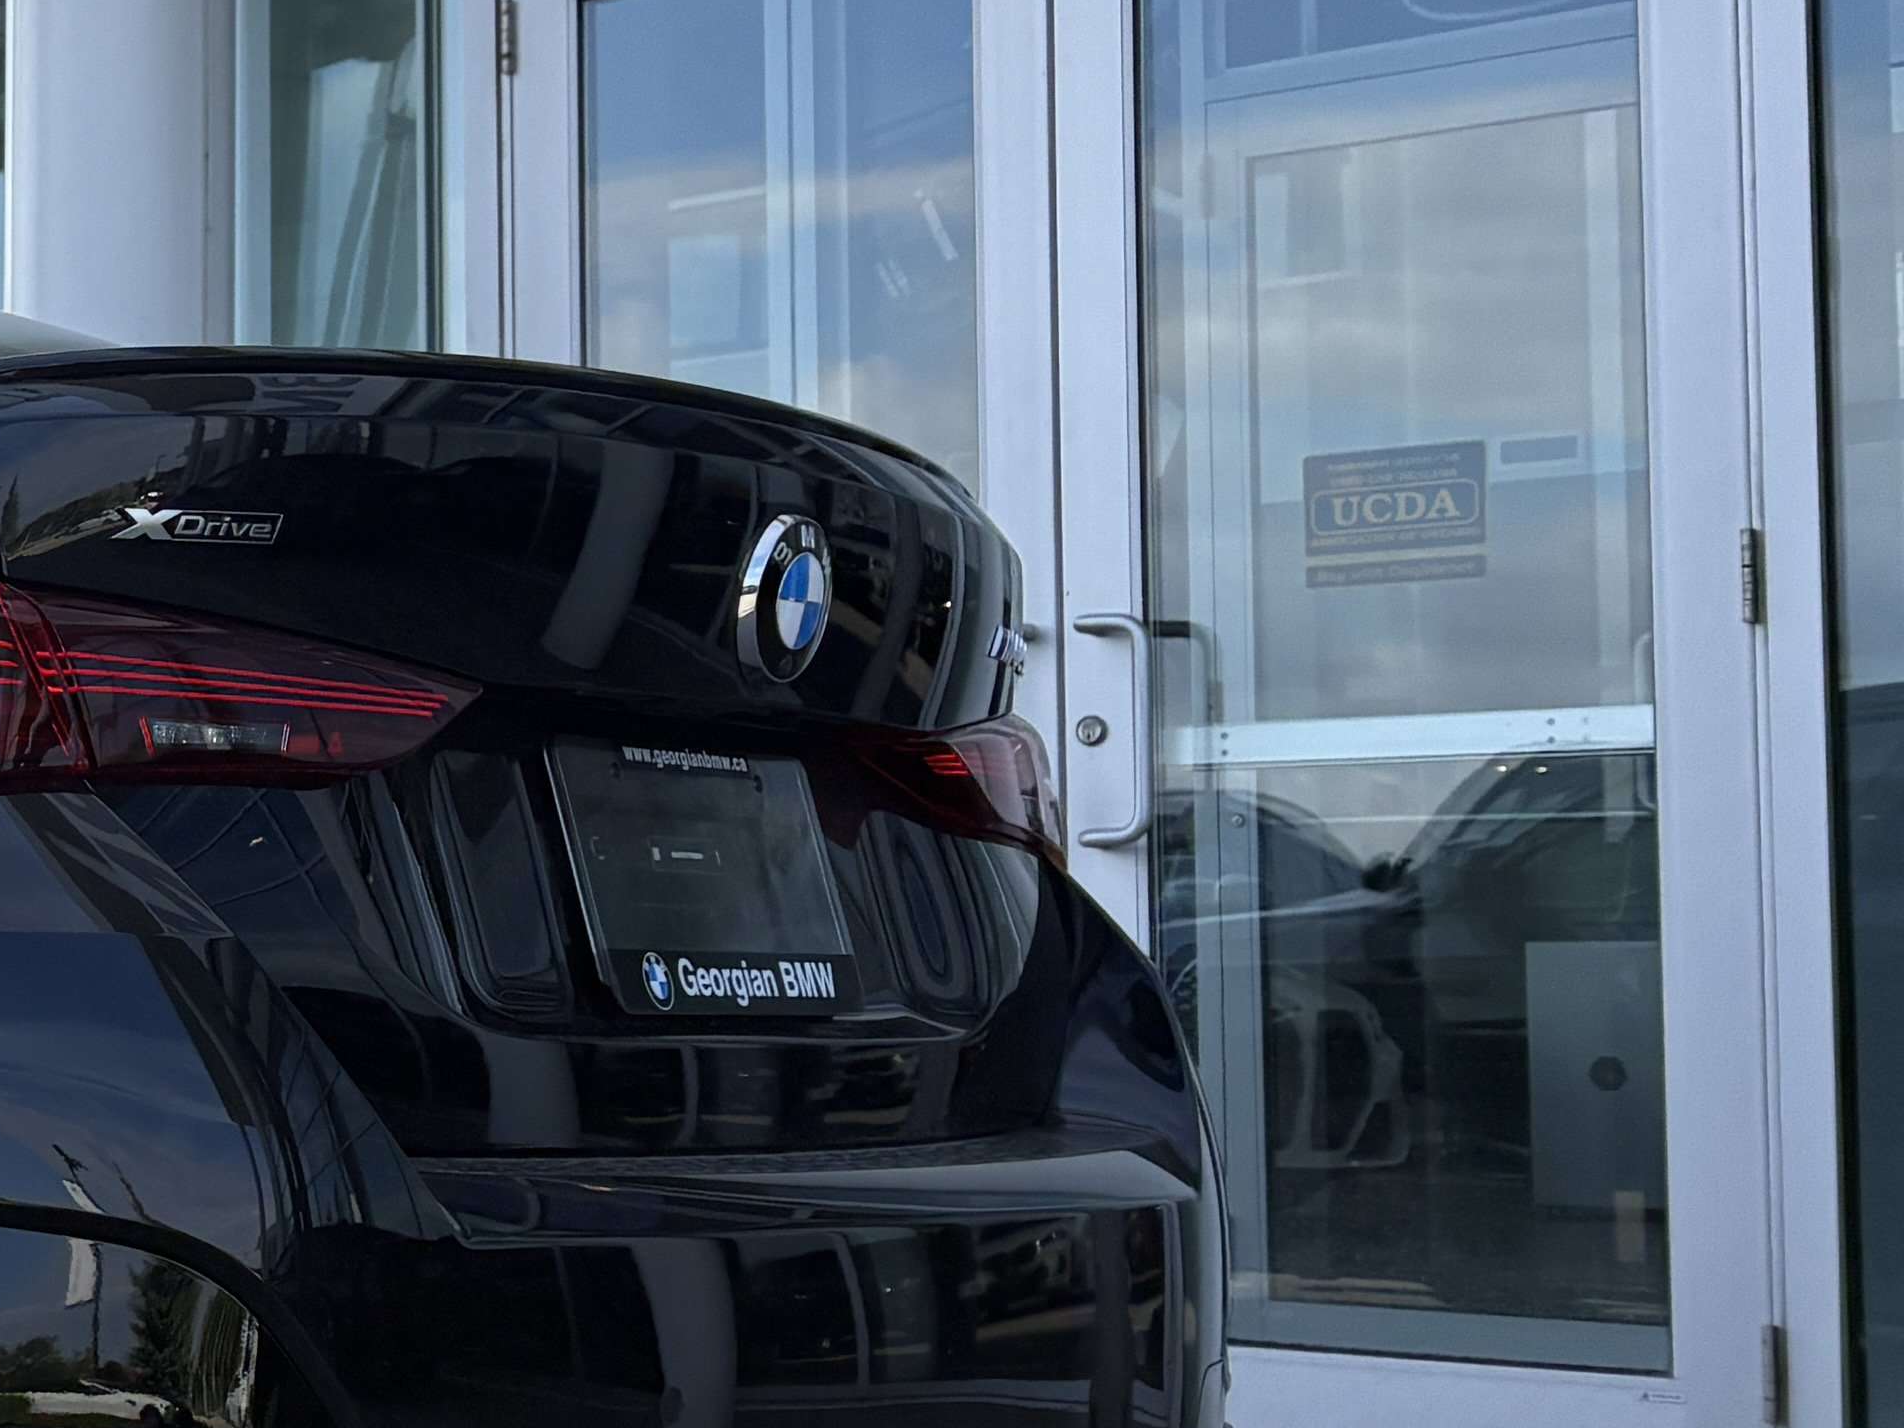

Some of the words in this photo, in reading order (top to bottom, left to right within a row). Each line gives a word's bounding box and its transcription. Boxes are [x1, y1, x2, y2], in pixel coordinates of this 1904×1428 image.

[1330, 487, 1461, 527] UCDA
[622, 745, 748, 772] www.georgianbmw.ca
[678, 957, 780, 1007] Georgian
[778, 961, 836, 999] BMW
